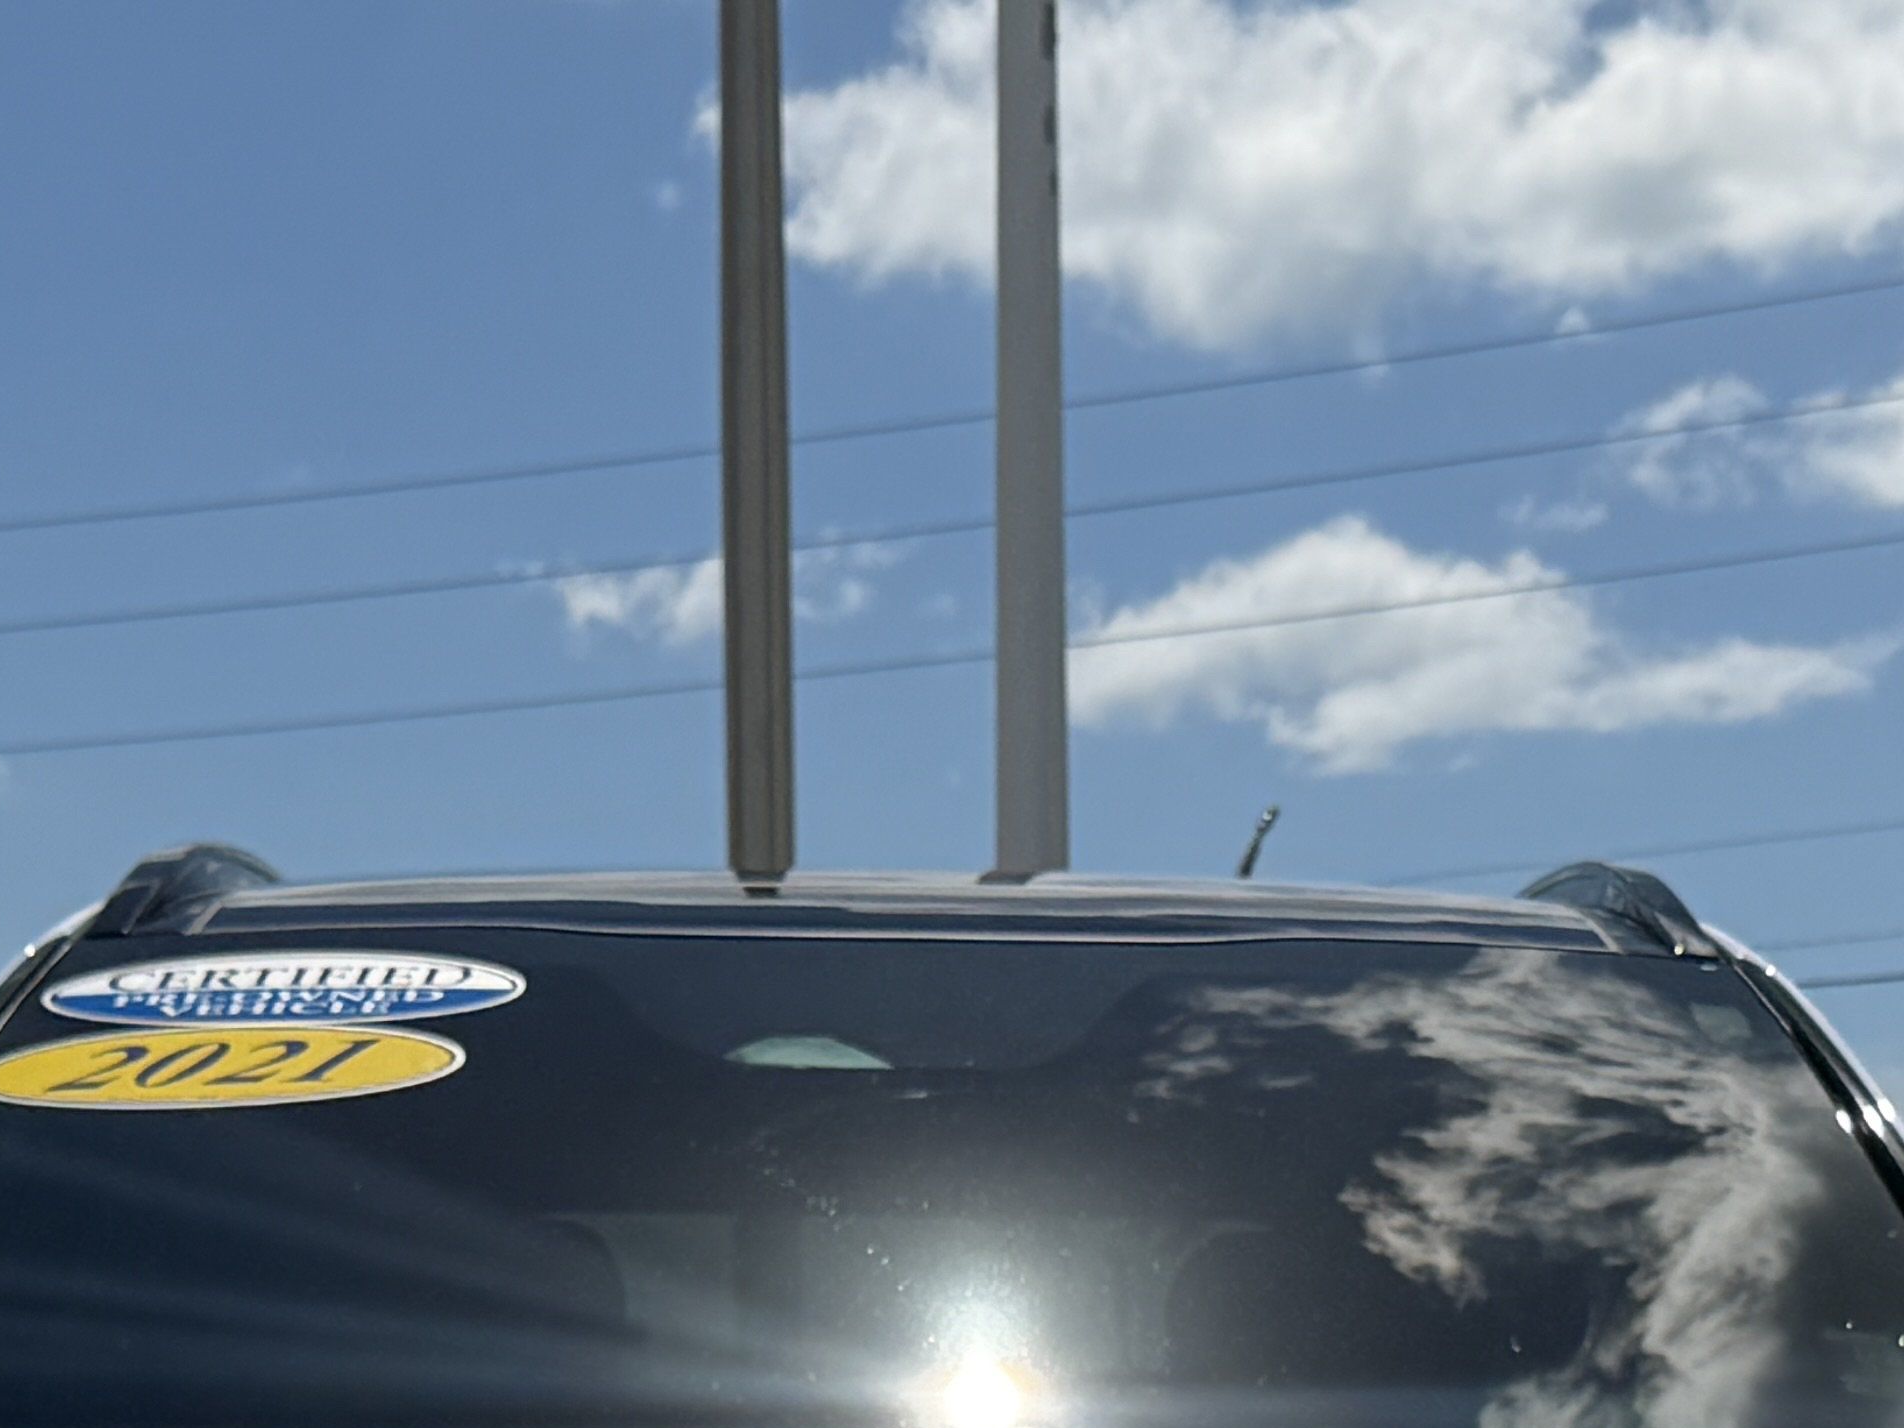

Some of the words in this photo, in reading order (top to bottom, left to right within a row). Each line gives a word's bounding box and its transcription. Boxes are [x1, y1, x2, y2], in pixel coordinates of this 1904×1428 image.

[109, 966, 471, 992] CERTIFIED
[160, 999, 391, 1018] VEHICLE
[44, 1038, 381, 1092] 2021
